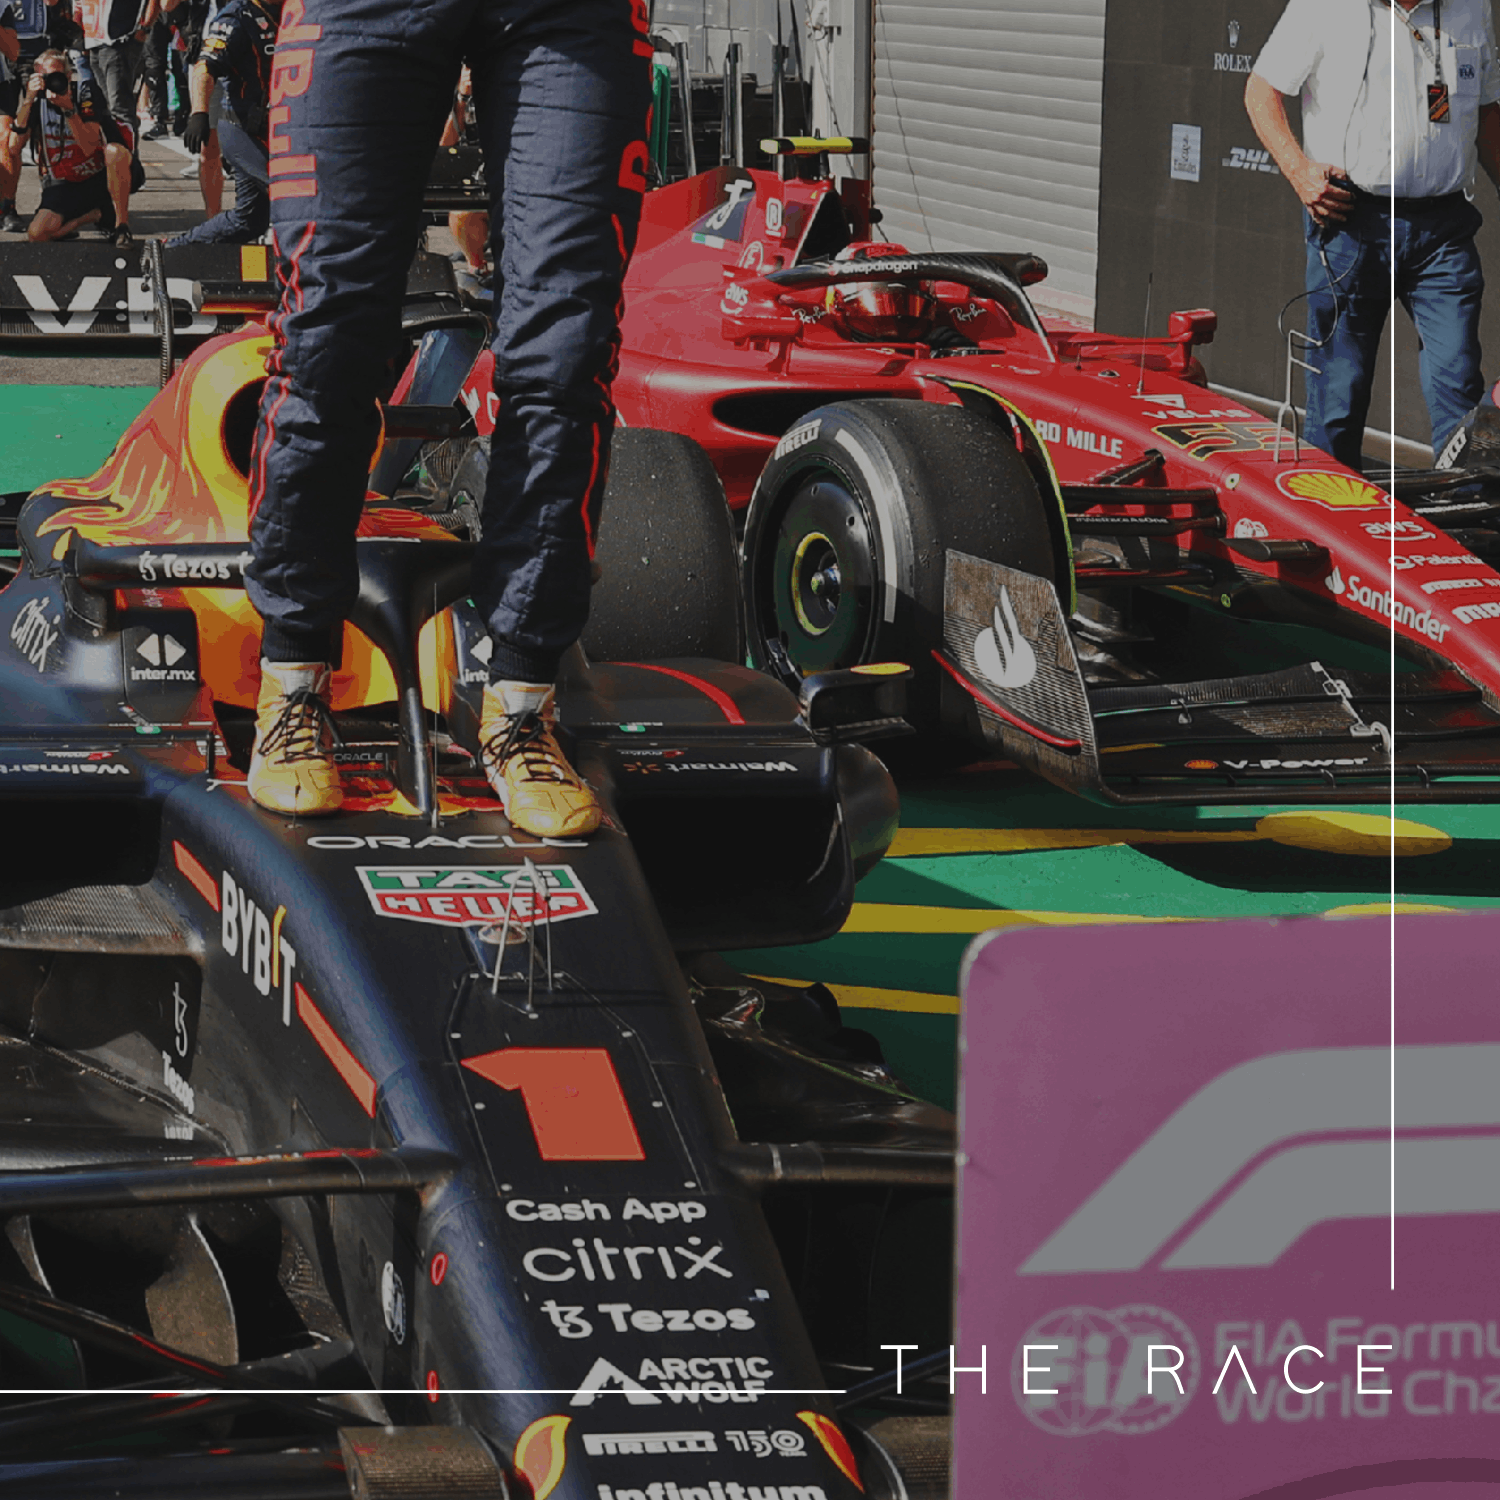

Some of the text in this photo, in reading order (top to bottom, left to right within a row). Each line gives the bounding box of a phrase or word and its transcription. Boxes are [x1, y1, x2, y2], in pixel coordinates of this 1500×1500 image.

[1213, 52, 1252, 74] ROLEX
[1229, 147, 1271, 171] DHL
[774, 417, 822, 461] PIRELLI
[1066, 428, 1123, 459] MILLE
[162, 552, 231, 580] Tezos
[1346, 575, 1451, 644] Santander
[130, 667, 197, 682] inter.mx
[333, 752, 384, 762] ORACLE
[665, 760, 798, 773] Walmart
[1223, 756, 1368, 770] V-Power
[375, 870, 555, 889] TAG
[391, 895, 581, 920] HEUER
[221, 870, 297, 1027] BYBIT
[460, 1047, 646, 1161] 1
[506, 1197, 707, 1224] Cash App
[522, 1236, 733, 1282] citrix
[597, 1302, 756, 1333] Tezos
[1214, 1320, 1318, 1366] FIA
[638, 1356, 774, 1381] ARCTIC
[658, 1380, 767, 1402] WOLF
[582, 1430, 718, 1456] PIRELLI
